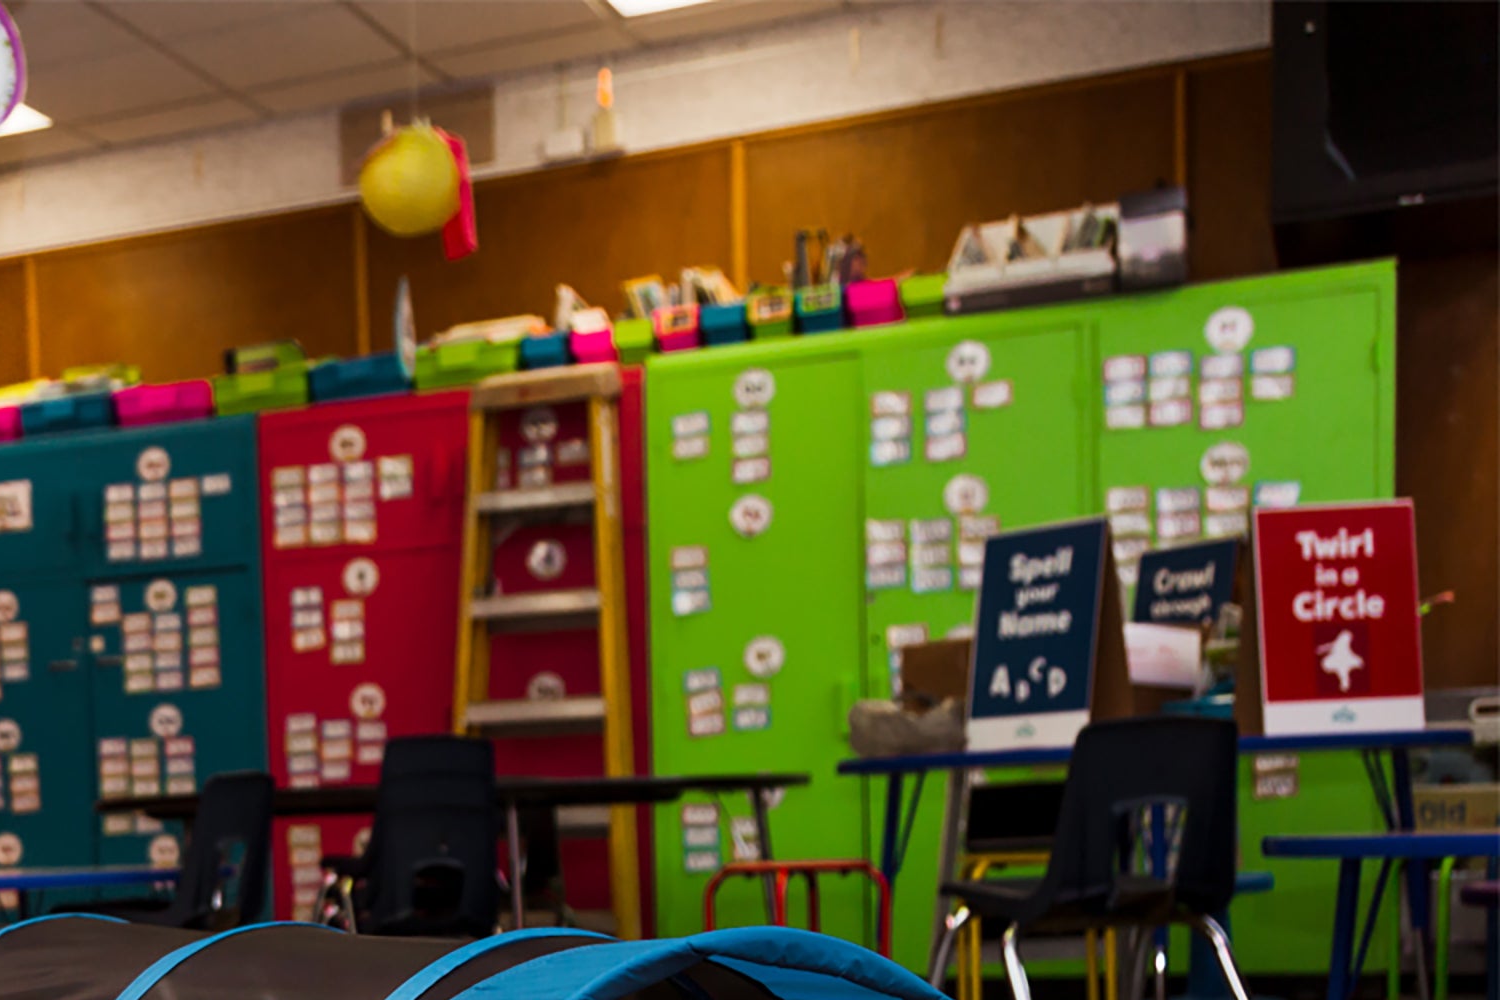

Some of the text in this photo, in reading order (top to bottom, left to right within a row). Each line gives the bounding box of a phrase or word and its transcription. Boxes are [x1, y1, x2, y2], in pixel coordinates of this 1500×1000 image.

[1295, 527, 1375, 560] Twirl
[1009, 548, 1073, 583] Spell
[1152, 561, 1218, 594] Crawl
[1314, 563, 1360, 587] in a
[1016, 583, 1060, 608] your
[1291, 589, 1385, 622] Circle
[997, 609, 1073, 640] Name
[1420, 799, 1467, 825] Old
